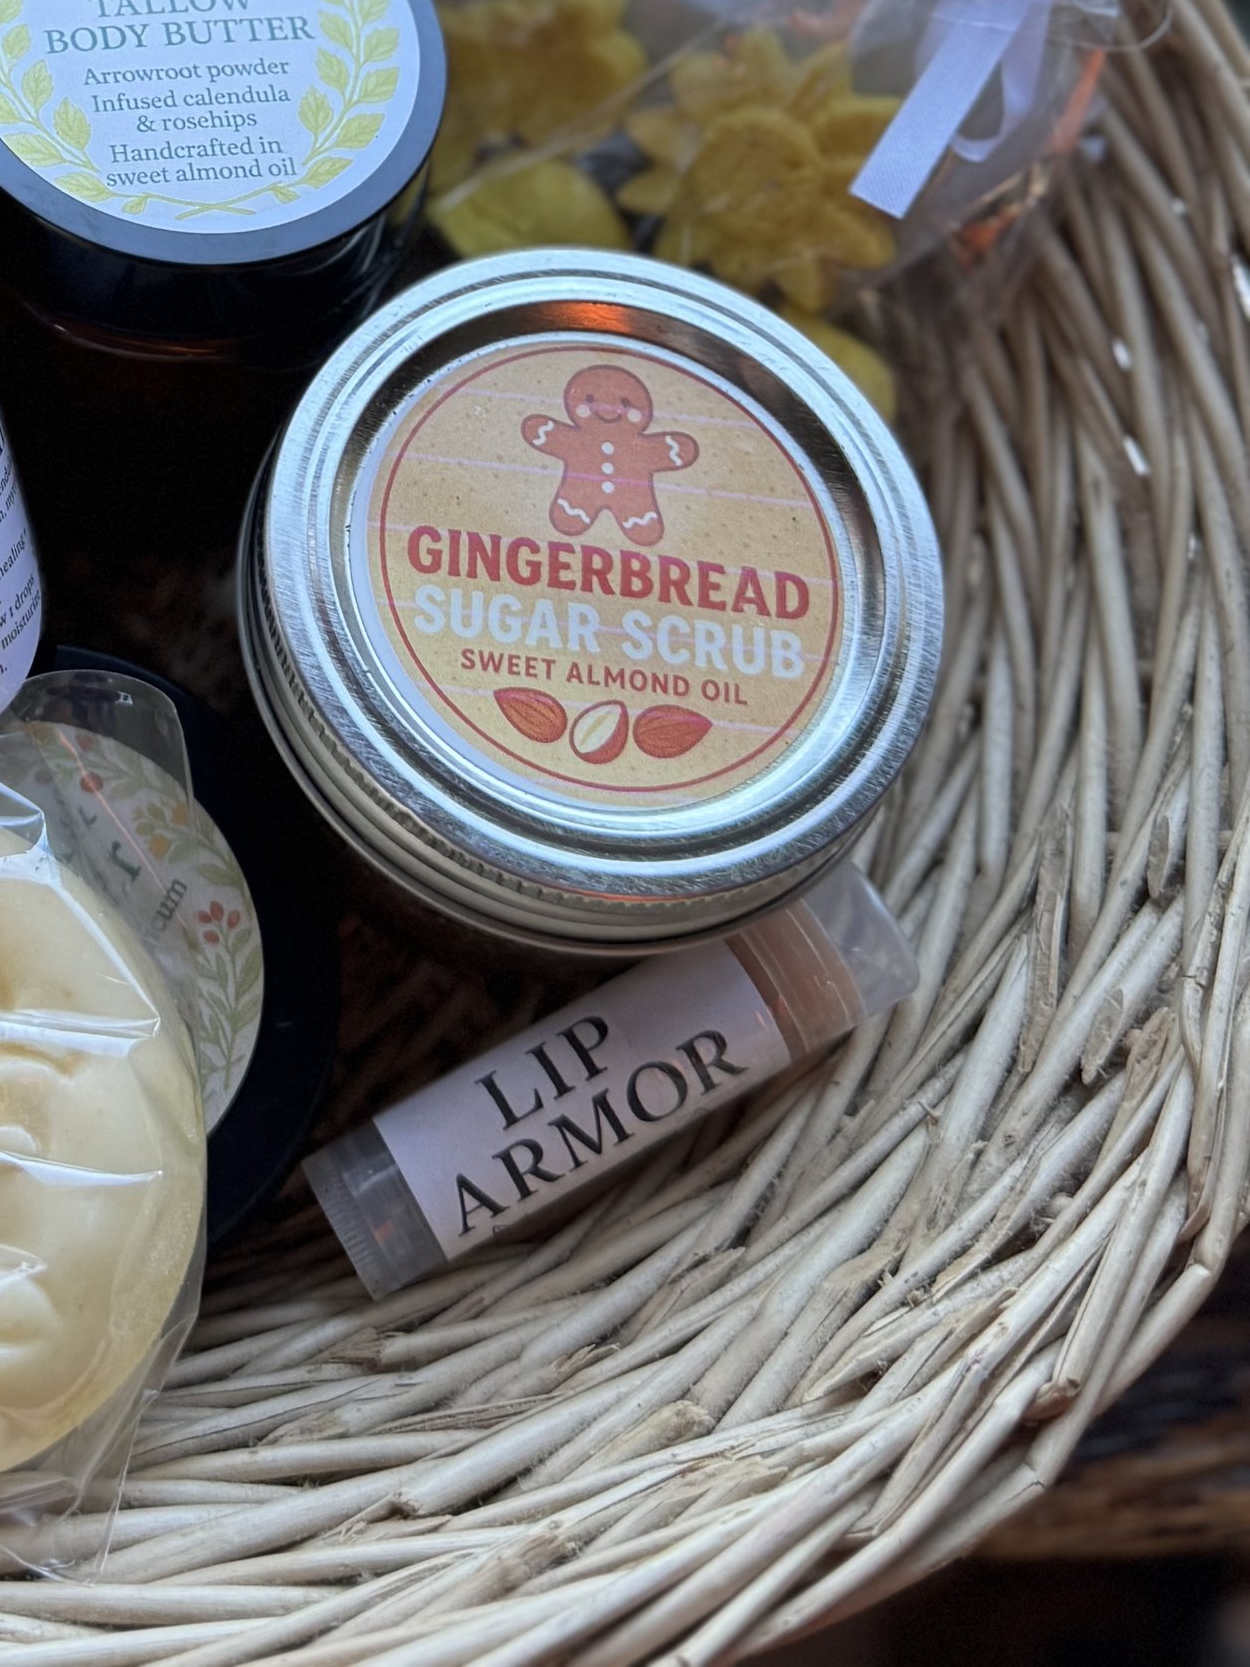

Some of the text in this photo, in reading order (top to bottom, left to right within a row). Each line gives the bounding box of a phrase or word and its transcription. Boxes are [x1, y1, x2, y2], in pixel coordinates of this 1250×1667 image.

[44, 15, 317, 54] BODY BUTTER
[83, 57, 291, 87] Arrowroot powder
[92, 86, 291, 114] Infused calendula
[136, 110, 258, 135] & rosehips
[110, 136, 283, 165] Handcrafted in
[106, 157, 298, 189] sweet almond oil
[406, 525, 811, 620] GINGERBREAD
[15, 573, 36, 613] drops
[413, 584, 805, 680] SUGAR SCRUB
[460, 647, 749, 706] SWEET ALMOND OIL
[475, 1015, 609, 1130] LIP
[454, 1029, 748, 1234] ARMOR
